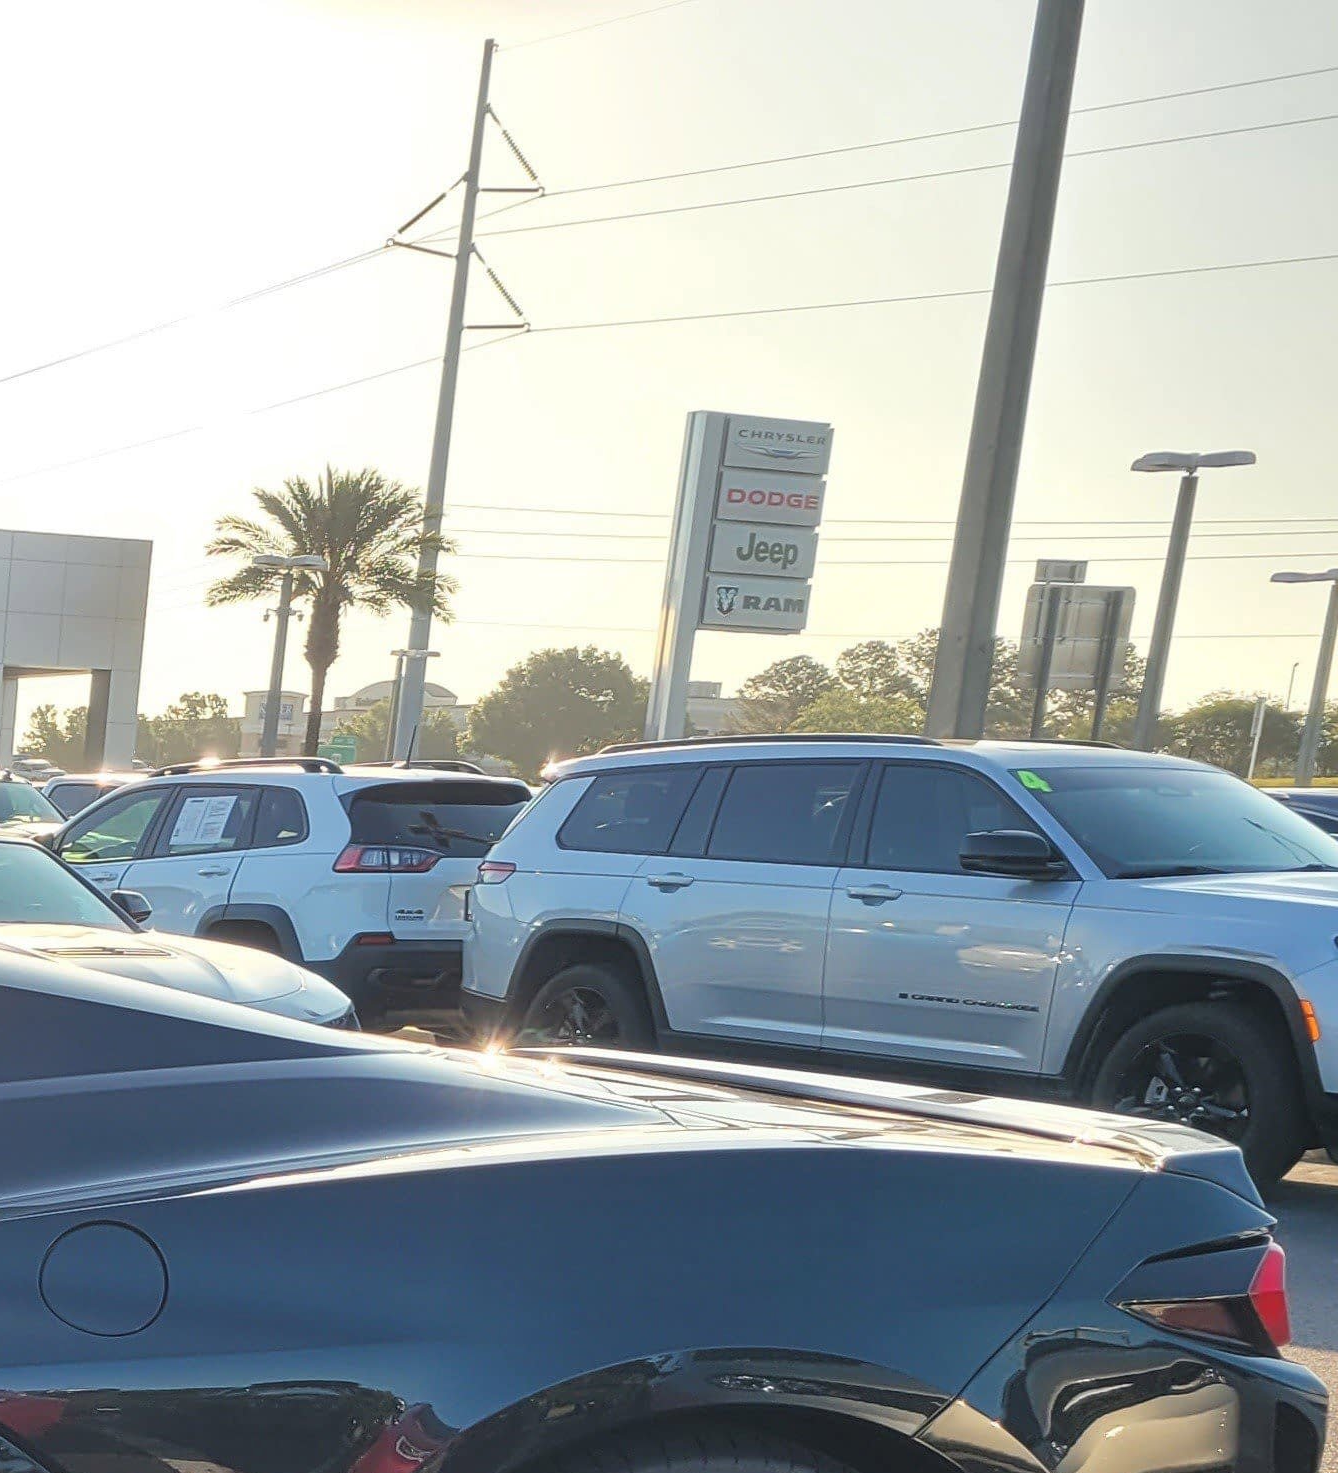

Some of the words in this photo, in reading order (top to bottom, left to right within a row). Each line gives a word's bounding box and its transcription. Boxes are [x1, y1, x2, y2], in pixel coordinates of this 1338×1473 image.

[738, 429, 826, 445] CHRYSLER
[727, 488, 820, 510] DODGE
[736, 533, 799, 569] Jeep
[742, 595, 804, 614] RAM
[1017, 770, 1053, 792] 4
